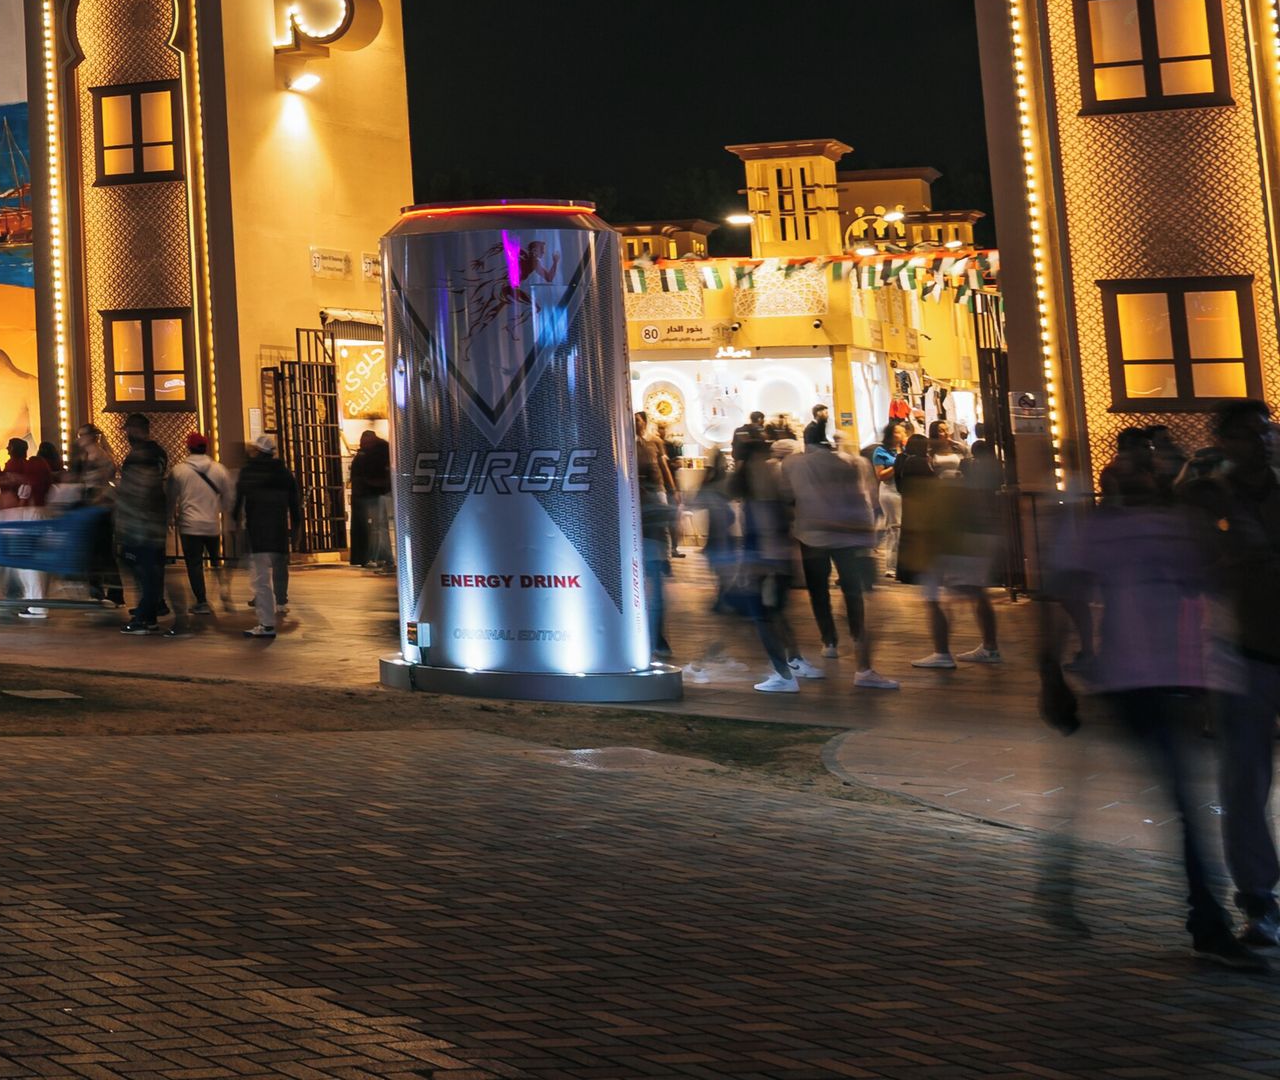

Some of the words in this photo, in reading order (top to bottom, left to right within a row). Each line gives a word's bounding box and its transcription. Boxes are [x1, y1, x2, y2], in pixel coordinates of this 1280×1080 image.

[643, 328, 659, 340] 80
[411, 448, 598, 495] SURGE
[439, 573, 515, 589] ENERGY
[519, 573, 582, 589] DRINK
[453, 627, 516, 641] ORIGINAL
